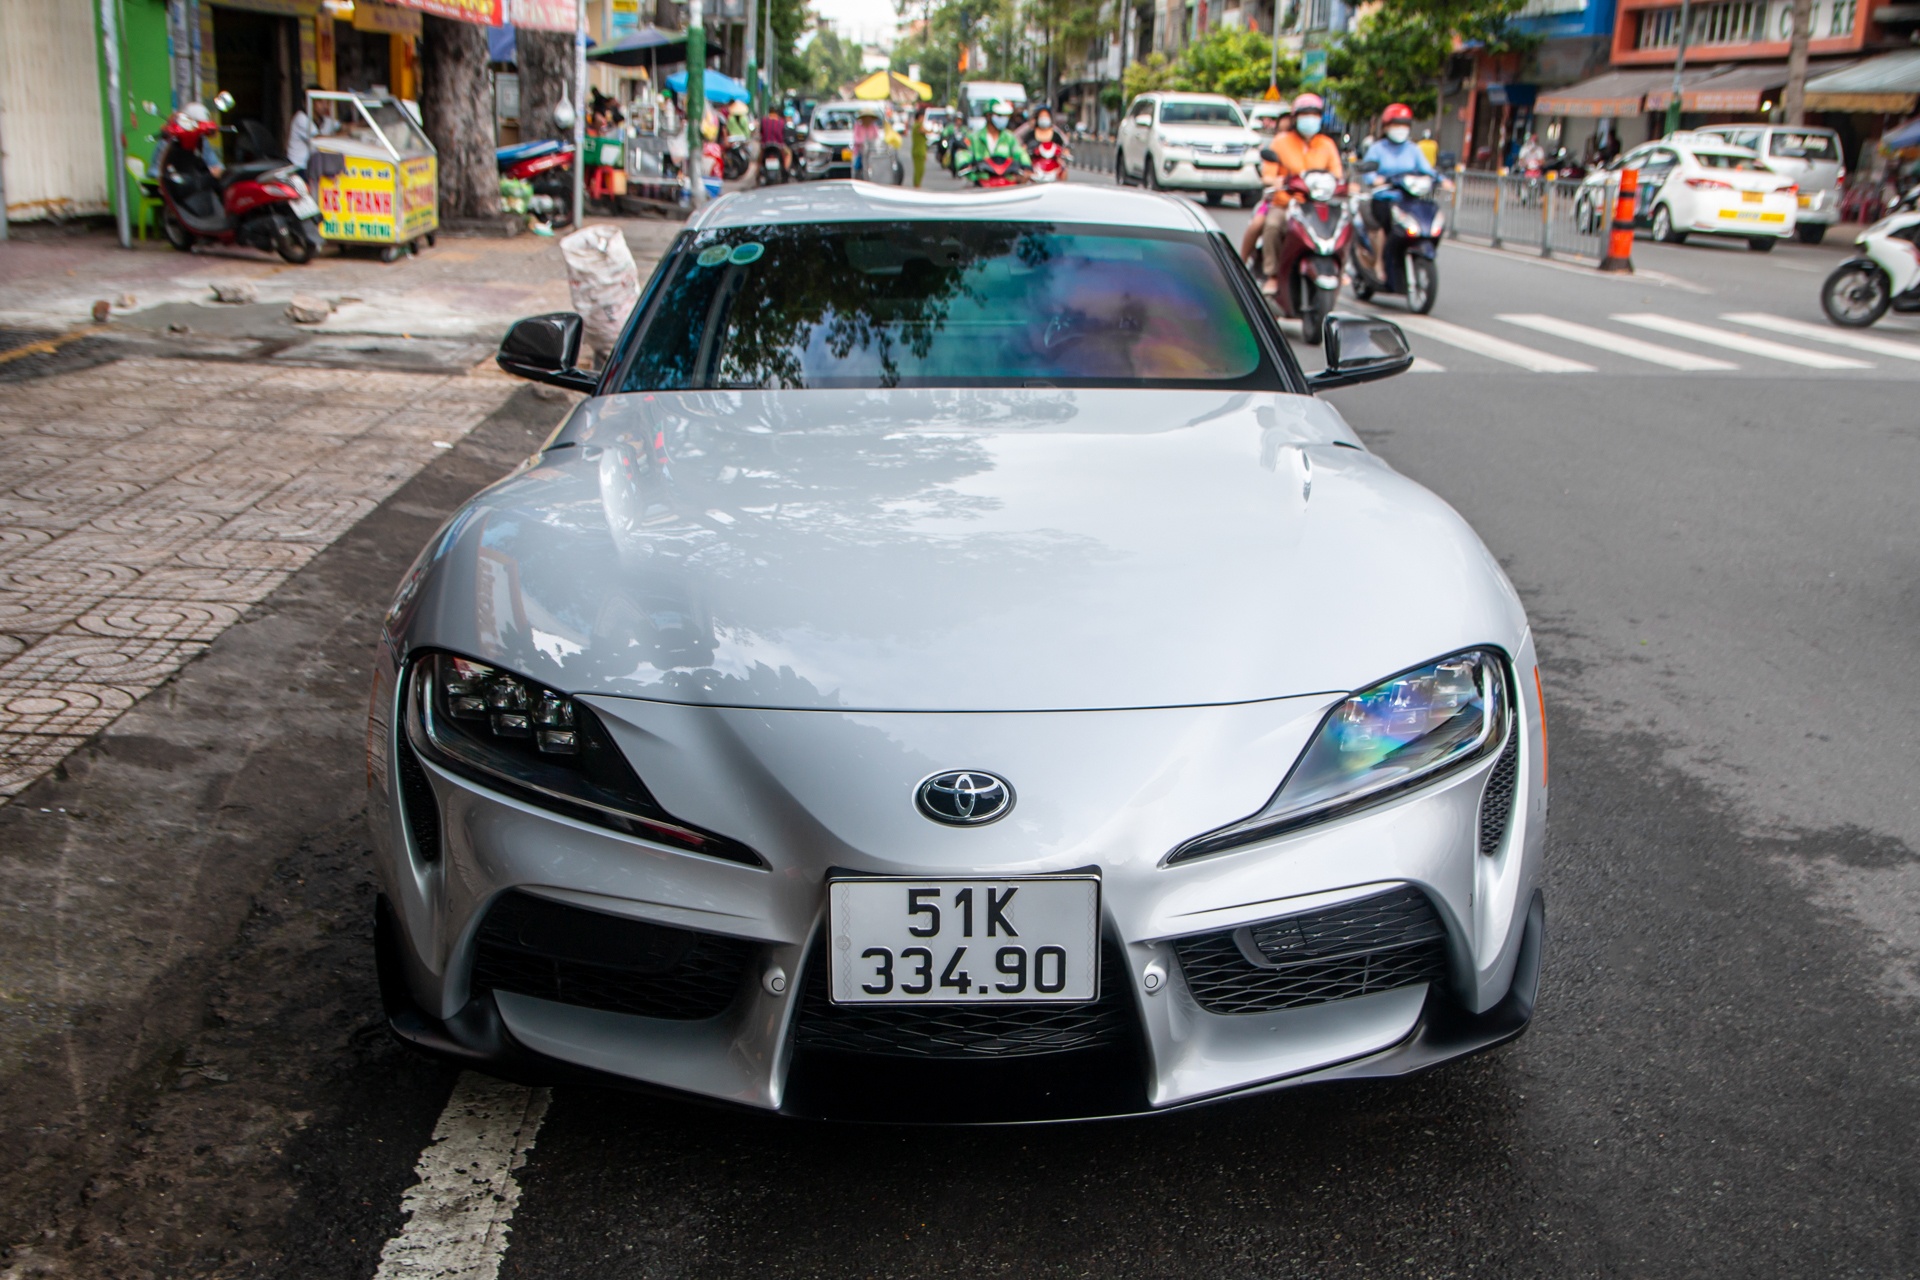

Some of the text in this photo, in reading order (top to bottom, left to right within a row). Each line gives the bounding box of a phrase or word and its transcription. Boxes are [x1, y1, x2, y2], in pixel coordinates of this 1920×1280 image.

[346, 190, 393, 214] THANH
[907, 887, 1020, 938] 51K
[861, 945, 1067, 995] 334.90
